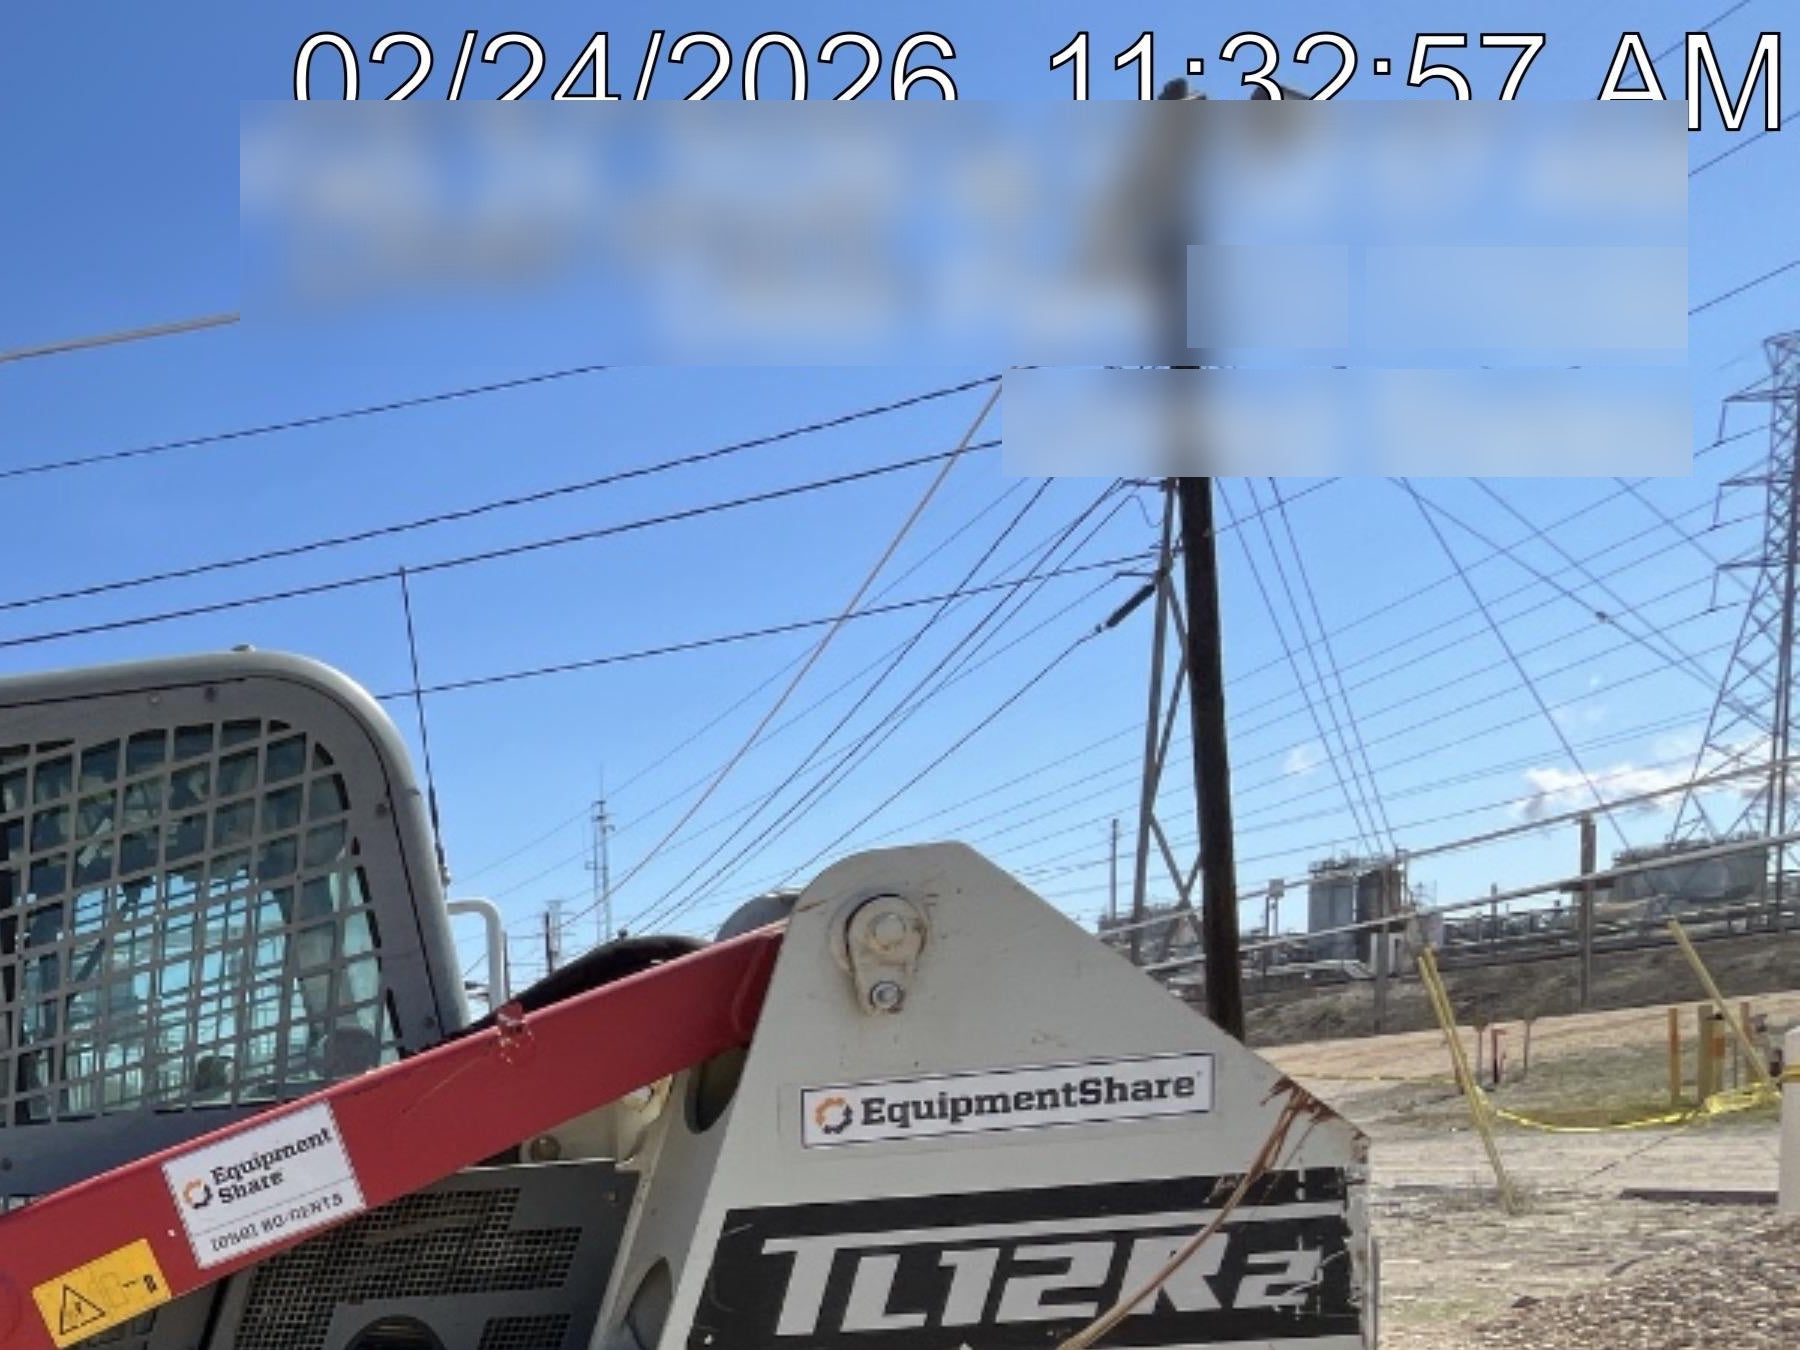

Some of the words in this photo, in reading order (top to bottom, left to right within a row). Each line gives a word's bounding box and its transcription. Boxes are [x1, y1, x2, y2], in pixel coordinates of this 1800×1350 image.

[860, 1073, 1196, 1127] EquipmentShare
[210, 1127, 332, 1184] Equipment
[218, 1170, 284, 1204] Share
[761, 1230, 1324, 1337] TL12R2
